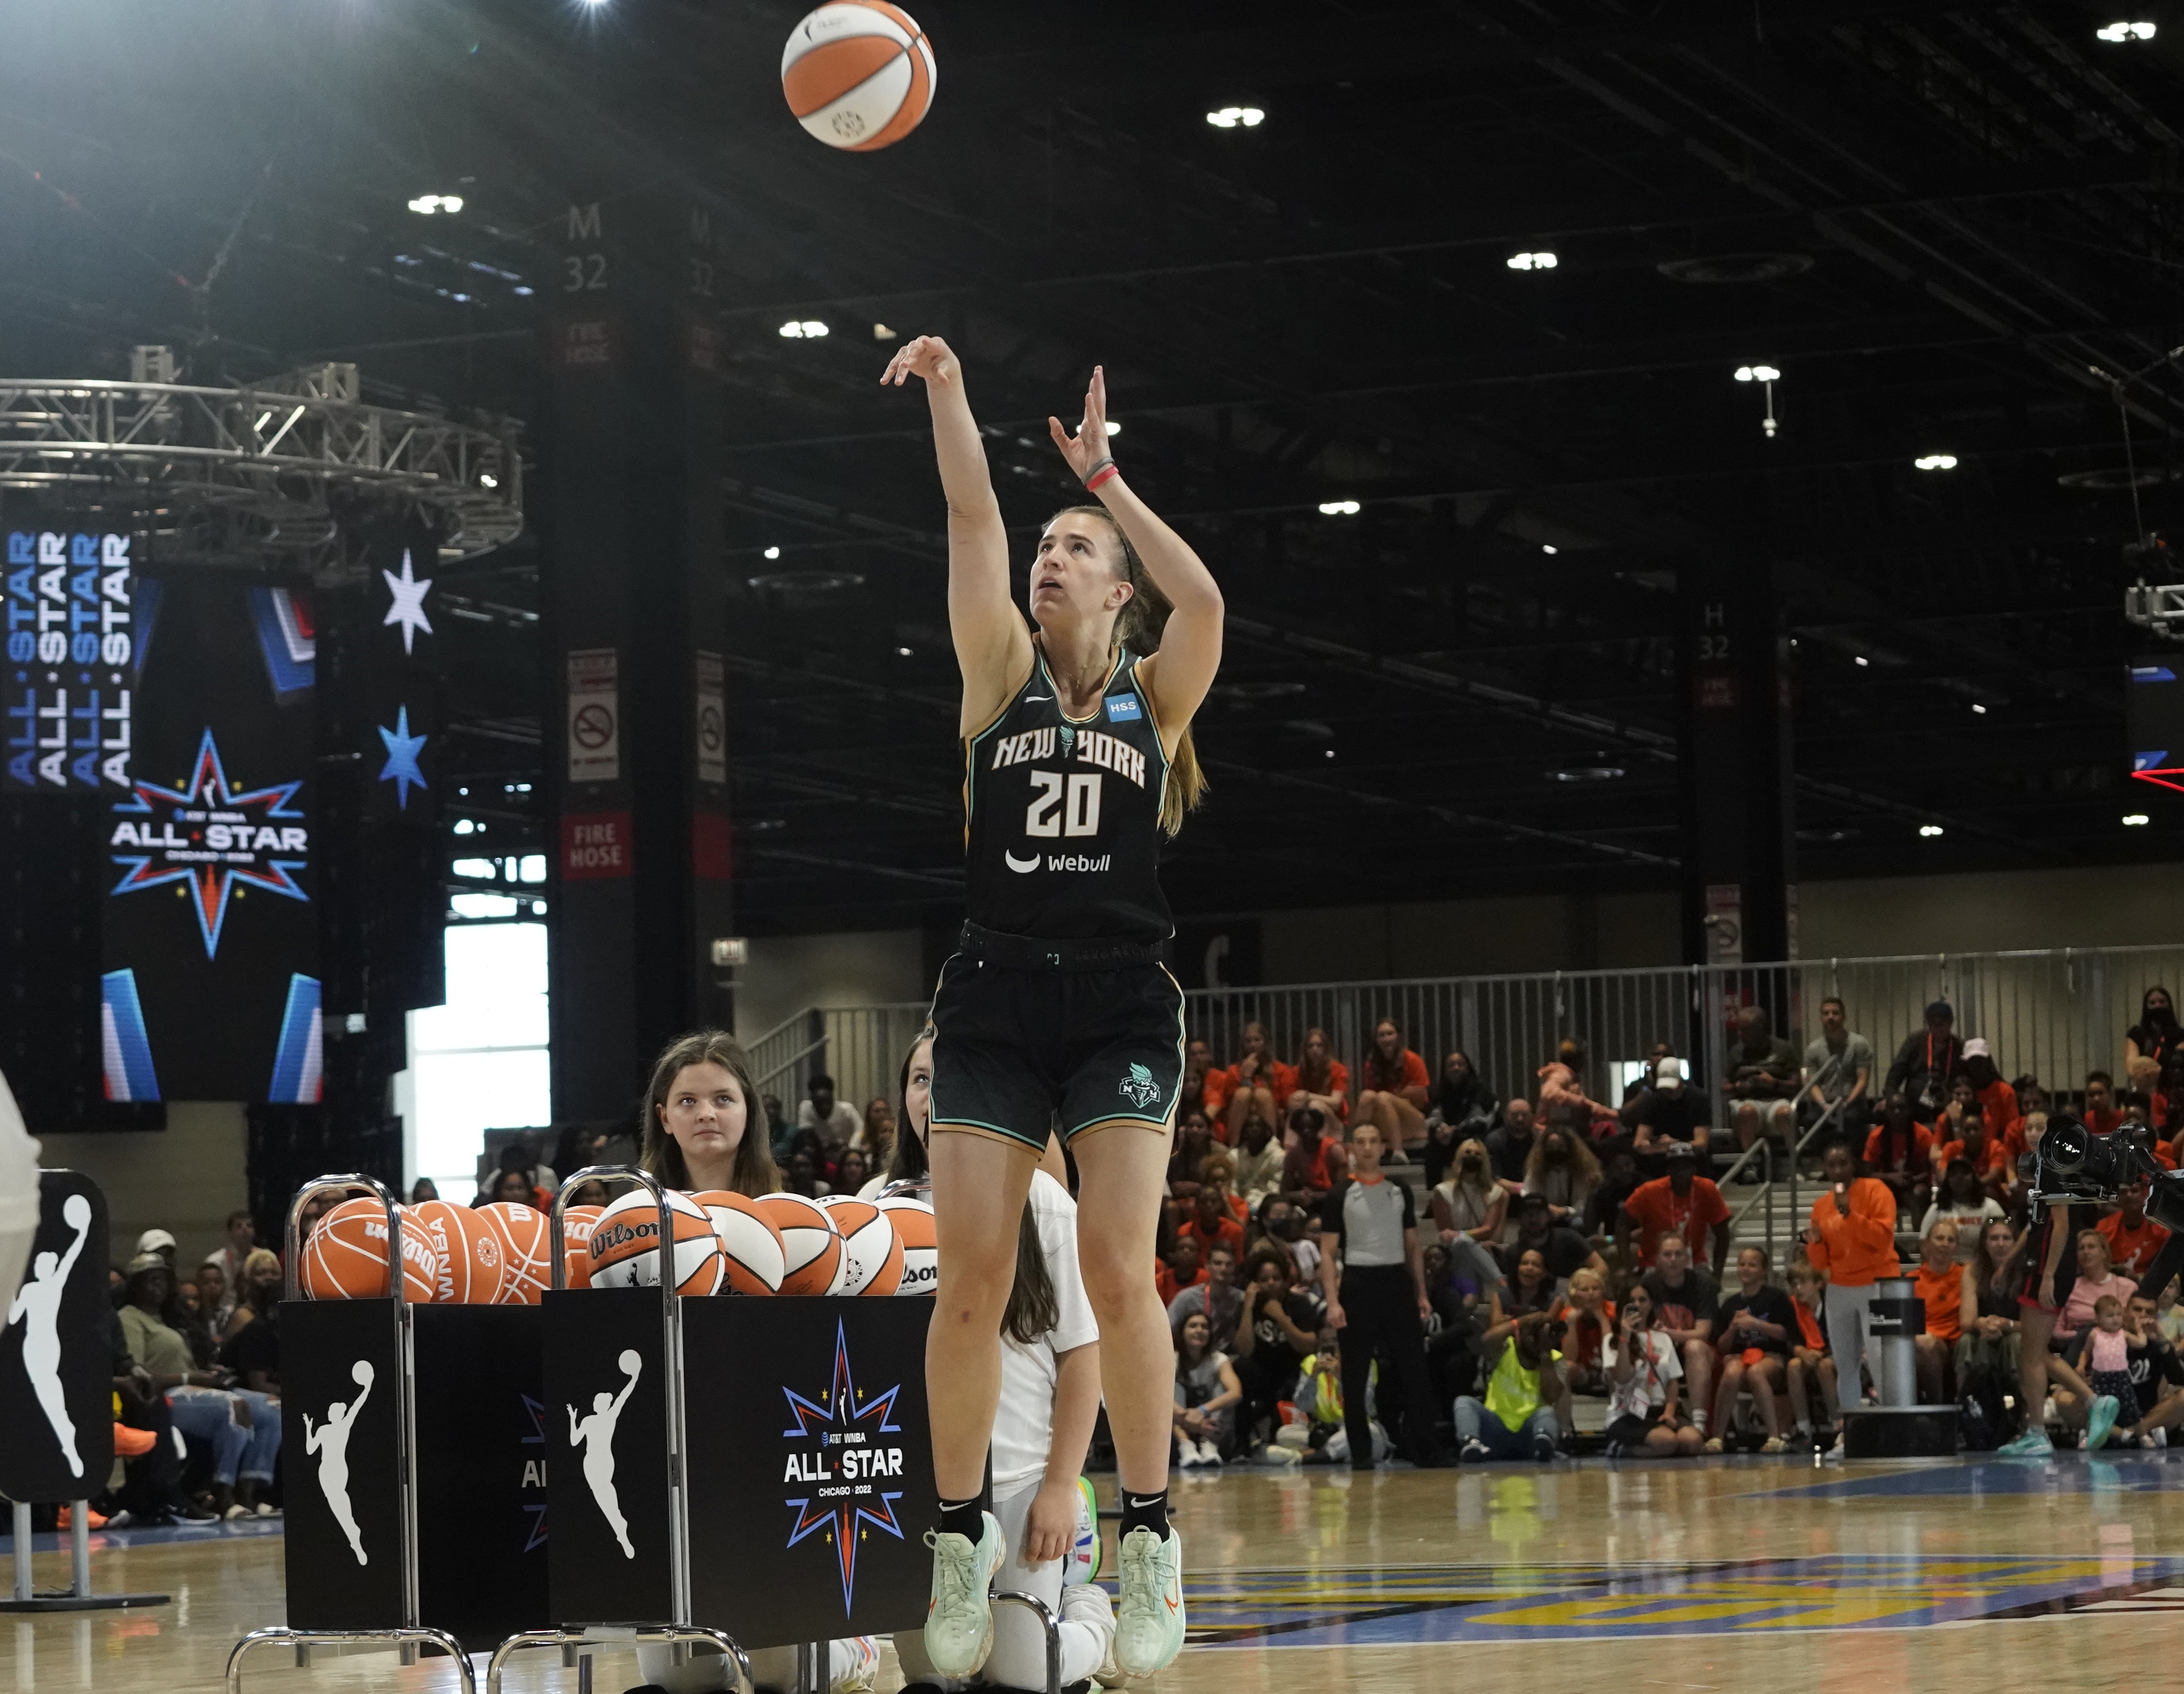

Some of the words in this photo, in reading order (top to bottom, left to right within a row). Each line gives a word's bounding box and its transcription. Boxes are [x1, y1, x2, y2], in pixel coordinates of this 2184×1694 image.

[568, 202, 601, 241] M
[563, 253, 608, 293] 32
[7, 530, 36, 665] STAR
[38, 531, 67, 665] STAR
[71, 532, 99, 665] STAR
[103, 533, 131, 665] STAR
[7, 689, 36, 786] ALL
[38, 689, 67, 787] ALL
[1110, 701, 1137, 713] HSS
[71, 690, 99, 787] ALL
[103, 690, 131, 788] ALL
[991, 727, 1056, 771] NEW
[1076, 730, 1145, 789] YORK
[573, 822, 617, 845] FIRE
[1026, 769, 1102, 838] 20
[110, 821, 189, 848] ALL
[205, 824, 308, 852] STAR
[570, 846, 622, 868] HOSE
[1048, 854, 1111, 872] Webull
[429, 1217, 454, 1301] WNBA
[784, 1452, 832, 1482] ALL
[842, 1448, 903, 1479] STAR
[829, 1433, 842, 1444] AT&T
[844, 1432, 866, 1443] WNBA
[818, 1486, 850, 1497] CHICAGO
[854, 1484, 872, 1494] 2022
